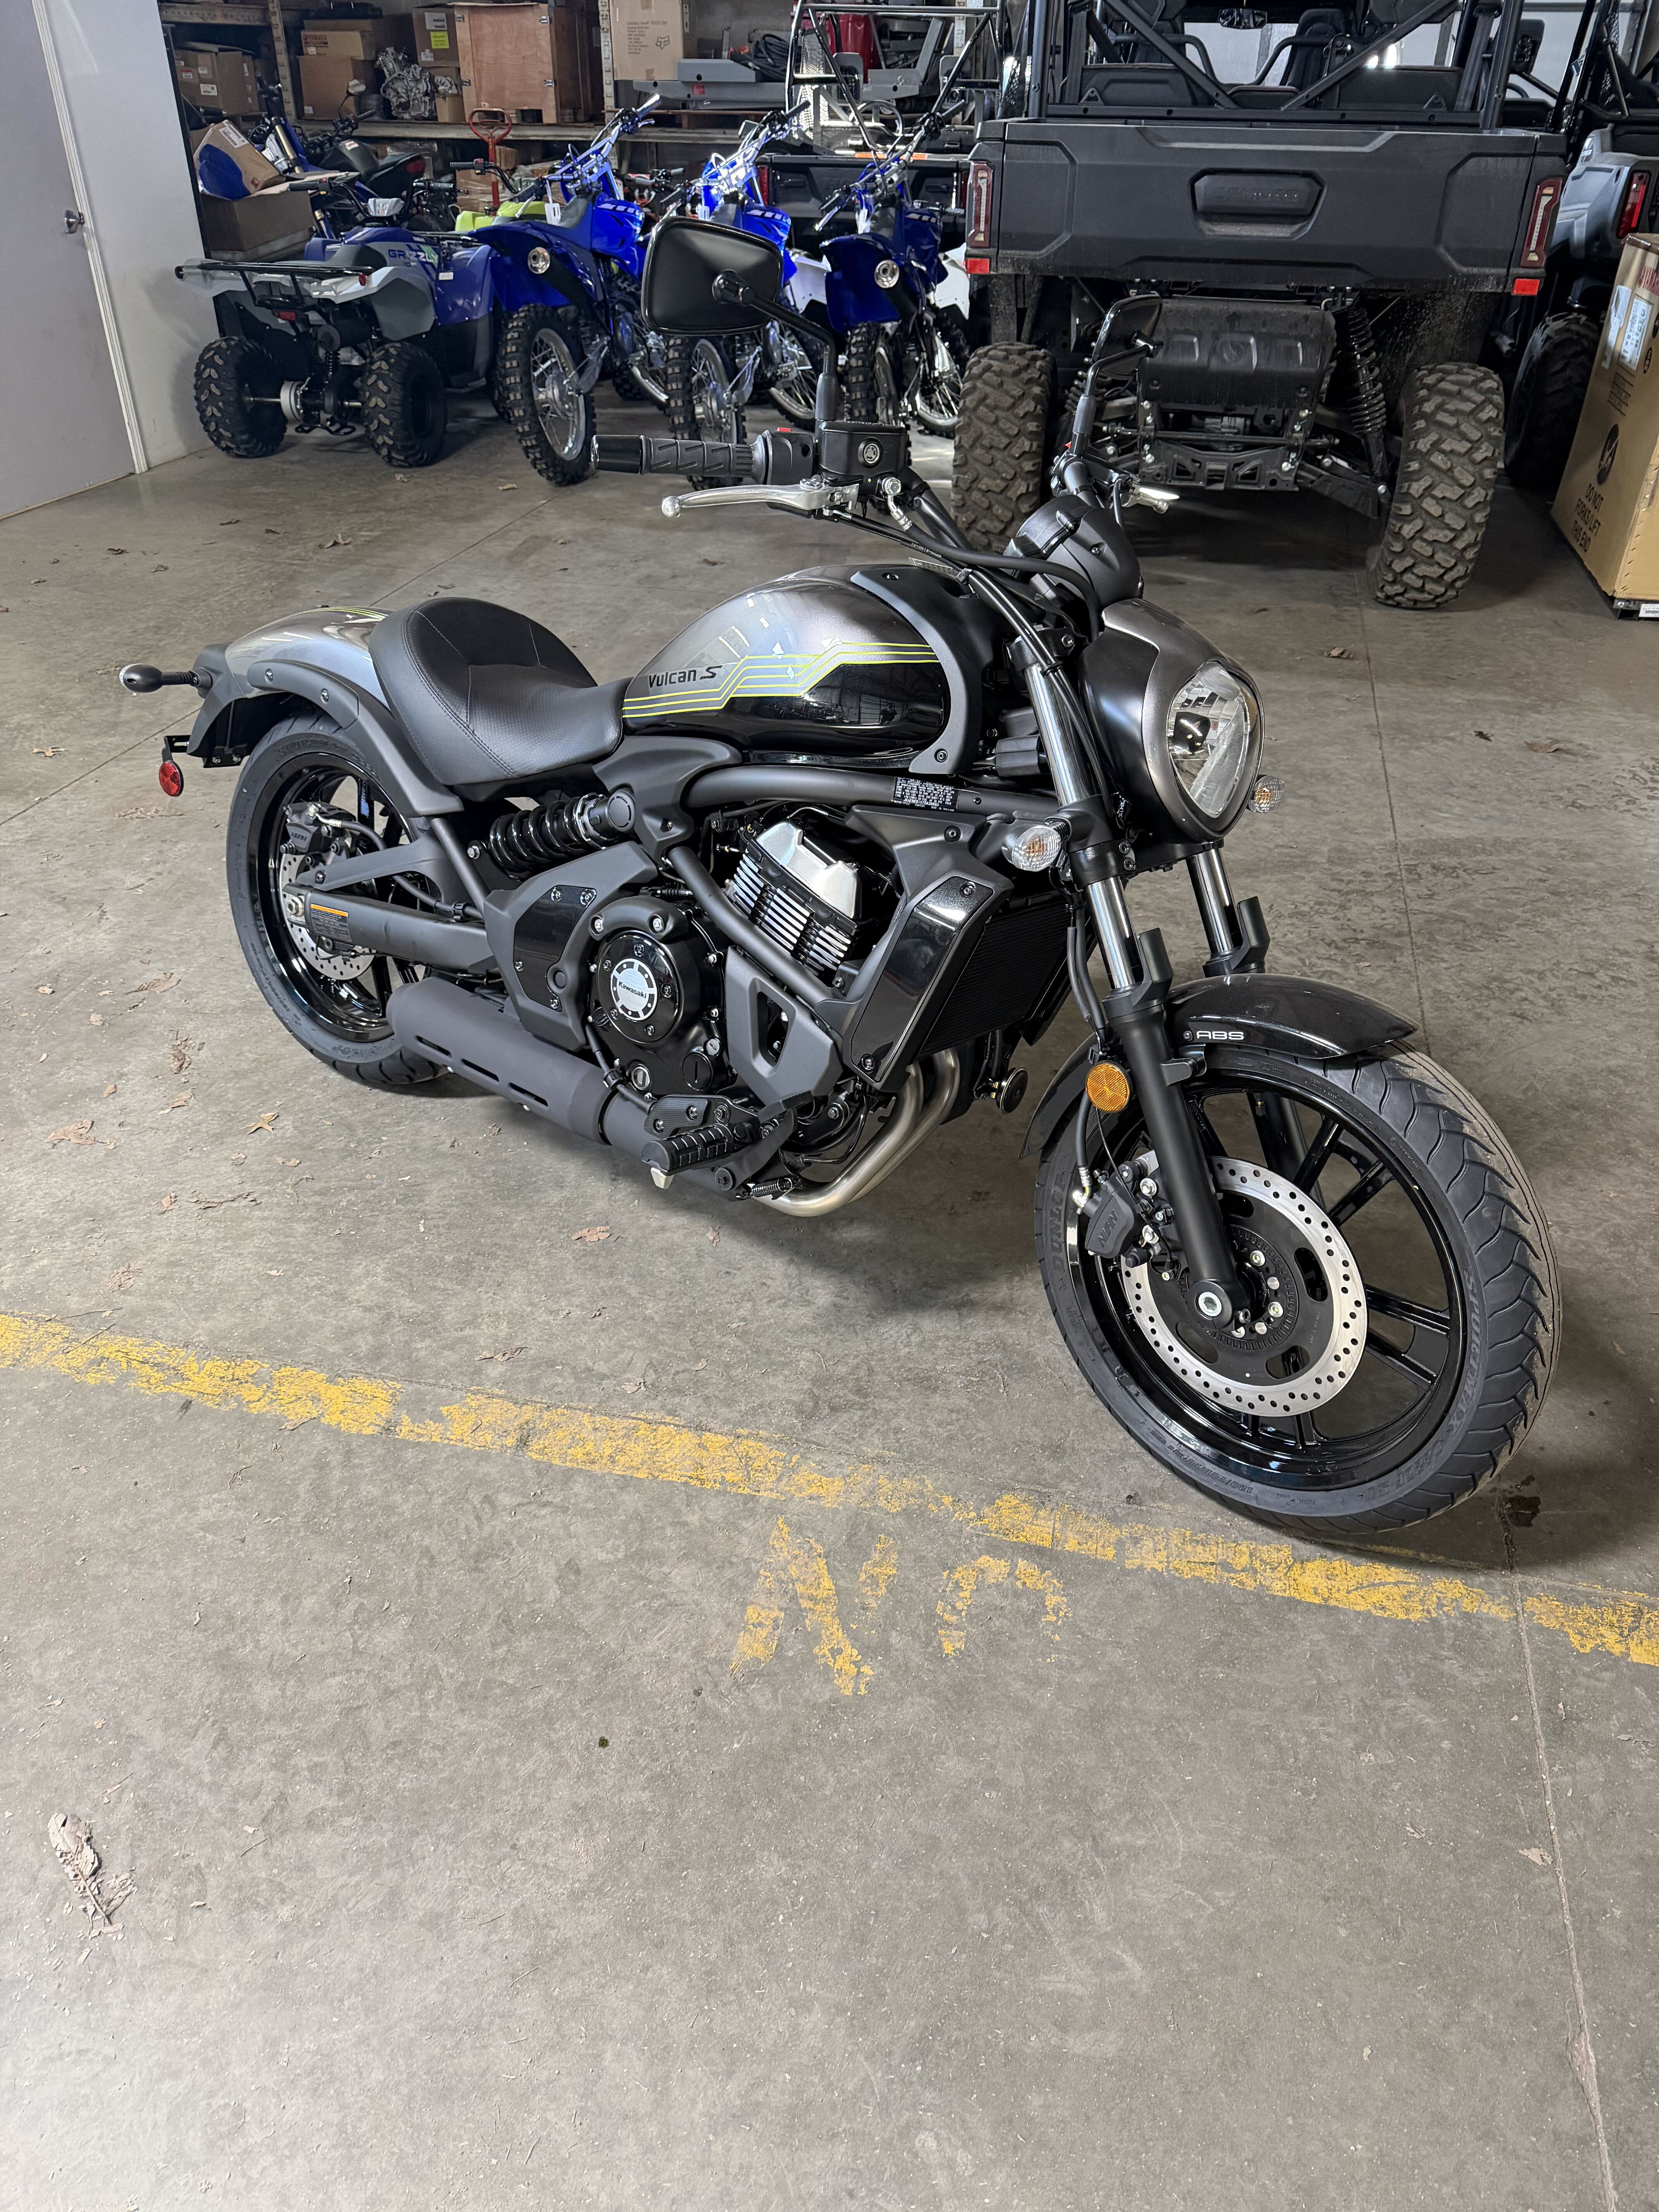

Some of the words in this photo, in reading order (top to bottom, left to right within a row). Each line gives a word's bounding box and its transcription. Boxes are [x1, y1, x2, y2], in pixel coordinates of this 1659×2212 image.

[1586, 483, 1594, 501] DO
[1592, 490, 1604, 512] NOT
[649, 670, 697, 688] Vulcan
[699, 665, 723, 680] S
[619, 981, 647, 999] Kawasaki
[1197, 1031, 1244, 1040] ABS
